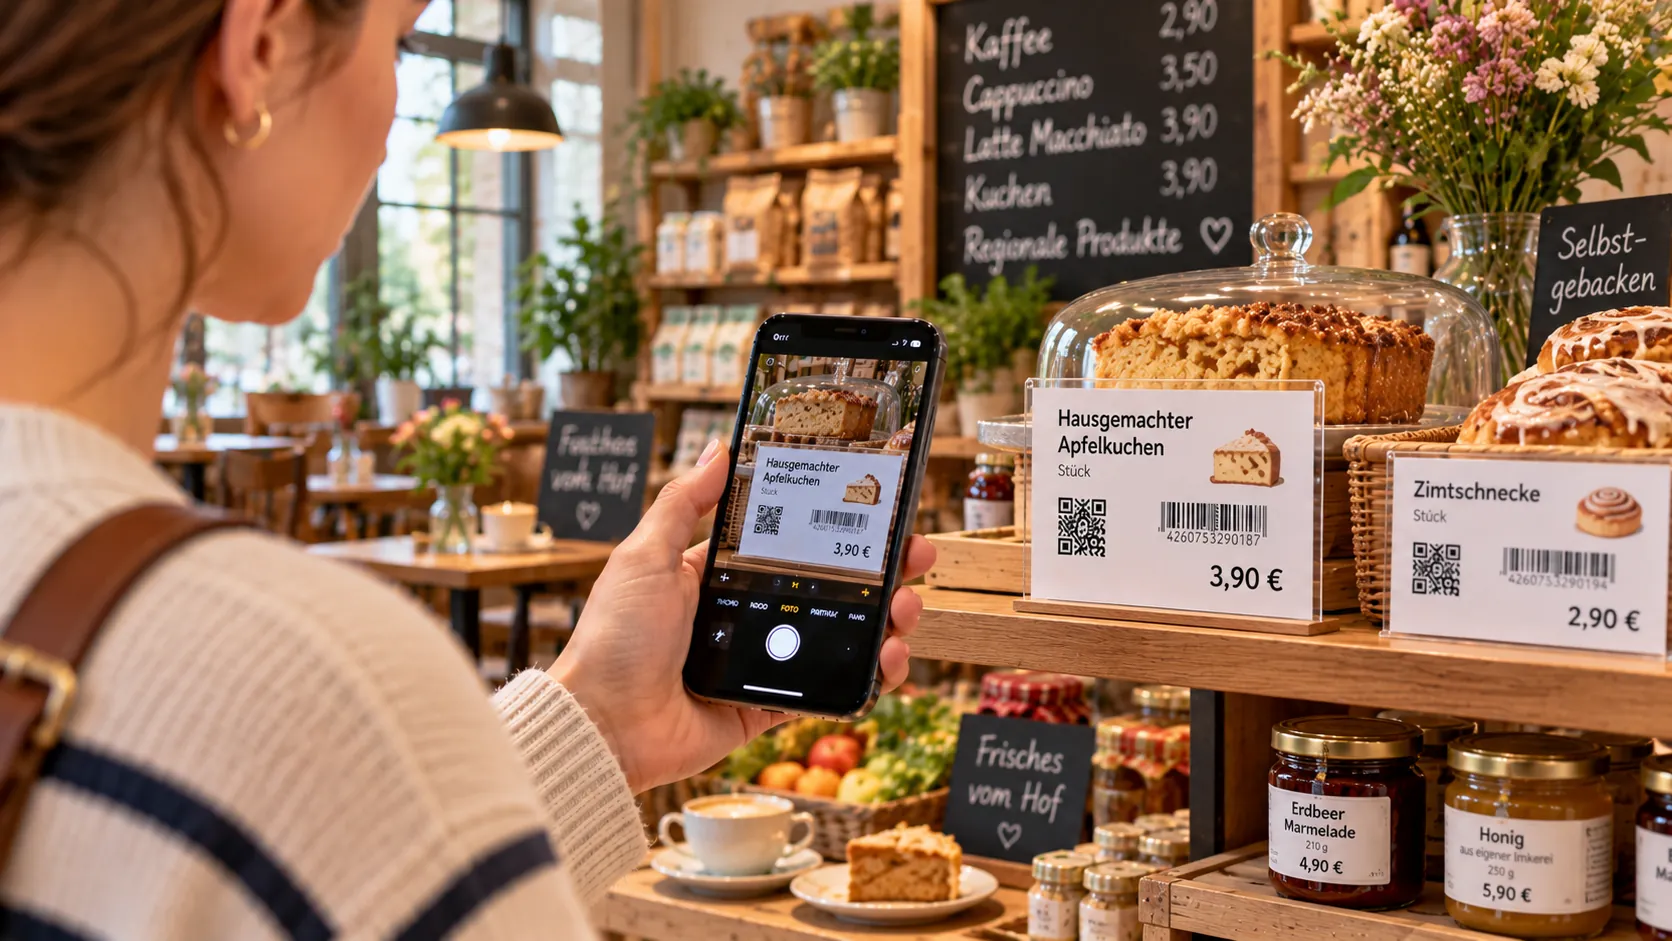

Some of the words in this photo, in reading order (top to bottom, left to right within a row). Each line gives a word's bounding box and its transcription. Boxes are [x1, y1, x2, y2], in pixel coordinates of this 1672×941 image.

[964, 16, 1053, 70] Kaffee
[1159, 0, 1218, 41] 2,90
[963, 69, 1094, 122] Cappuccino
[1160, 50, 1218, 93] 3,50
[964, 125, 1024, 163] Latte
[1029, 111, 1148, 156] Macchiato
[1160, 103, 1218, 145] 3,90
[964, 172, 1053, 213] Kuchen
[1160, 157, 1218, 199] 3,90
[964, 221, 1069, 276] Regionale
[1076, 215, 1184, 257] Produkte
[1558, 223, 1647, 260] Selbst-
[1549, 262, 1656, 315] gebacken
[1058, 409, 1193, 432] Hausgemachter
[1058, 435, 1164, 458] Apfelkuchen
[766, 457, 840, 473] Hausgemachter
[1058, 464, 1091, 478] Stück
[763, 472, 820, 487] Apfelkuchen
[1414, 480, 1540, 503] Zimtschnecke
[833, 542, 859, 557] 3,90
[862, 546, 871, 558] €
[1166, 531, 1261, 546] 4260753290187
[1210, 564, 1260, 592] 3,90
[1267, 568, 1284, 592] €
[780, 604, 799, 614] FOTO
[1568, 606, 1617, 630] 2,90
[1625, 610, 1641, 631] €
[975, 734, 1064, 774] Frisches
[968, 783, 1012, 809] vom
[1020, 780, 1067, 824] Hof
[1292, 801, 1345, 820] Erdbeer
[1284, 818, 1356, 839] Marmelade
[1480, 826, 1525, 850] Honig
[1305, 840, 1320, 851] 210
[1322, 844, 1328, 853] g
[1460, 845, 1474, 856] aus
[1476, 847, 1511, 862] eigener
[1514, 853, 1553, 864] Imkerei
[1299, 857, 1329, 874] 4,90
[1333, 860, 1344, 875] €
[1488, 865, 1505, 876] 250
[1507, 869, 1514, 880] g
[1482, 883, 1516, 902] 5,90
[1521, 888, 1532, 903] €
